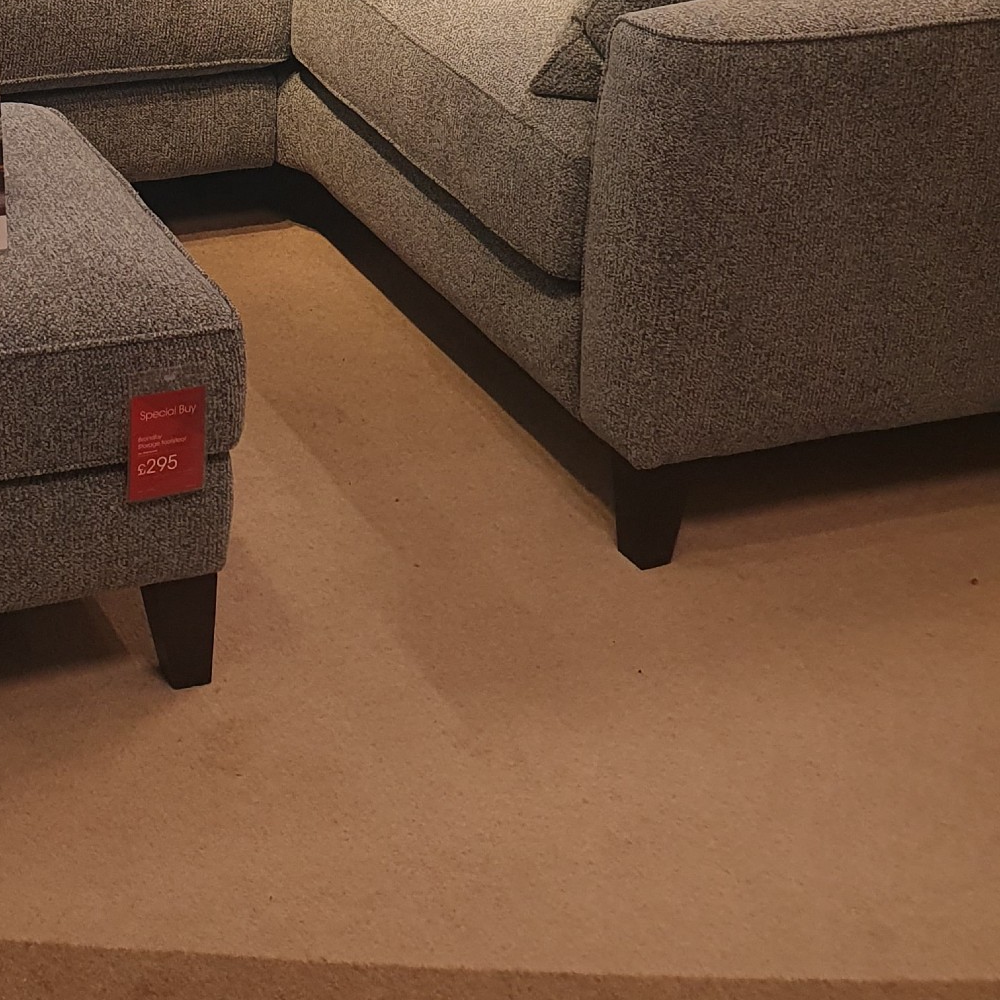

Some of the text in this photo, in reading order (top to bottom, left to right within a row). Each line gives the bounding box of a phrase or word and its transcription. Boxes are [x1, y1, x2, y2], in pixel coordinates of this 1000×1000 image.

[139, 404, 197, 421] Special Buy
[137, 454, 178, 476] £295
